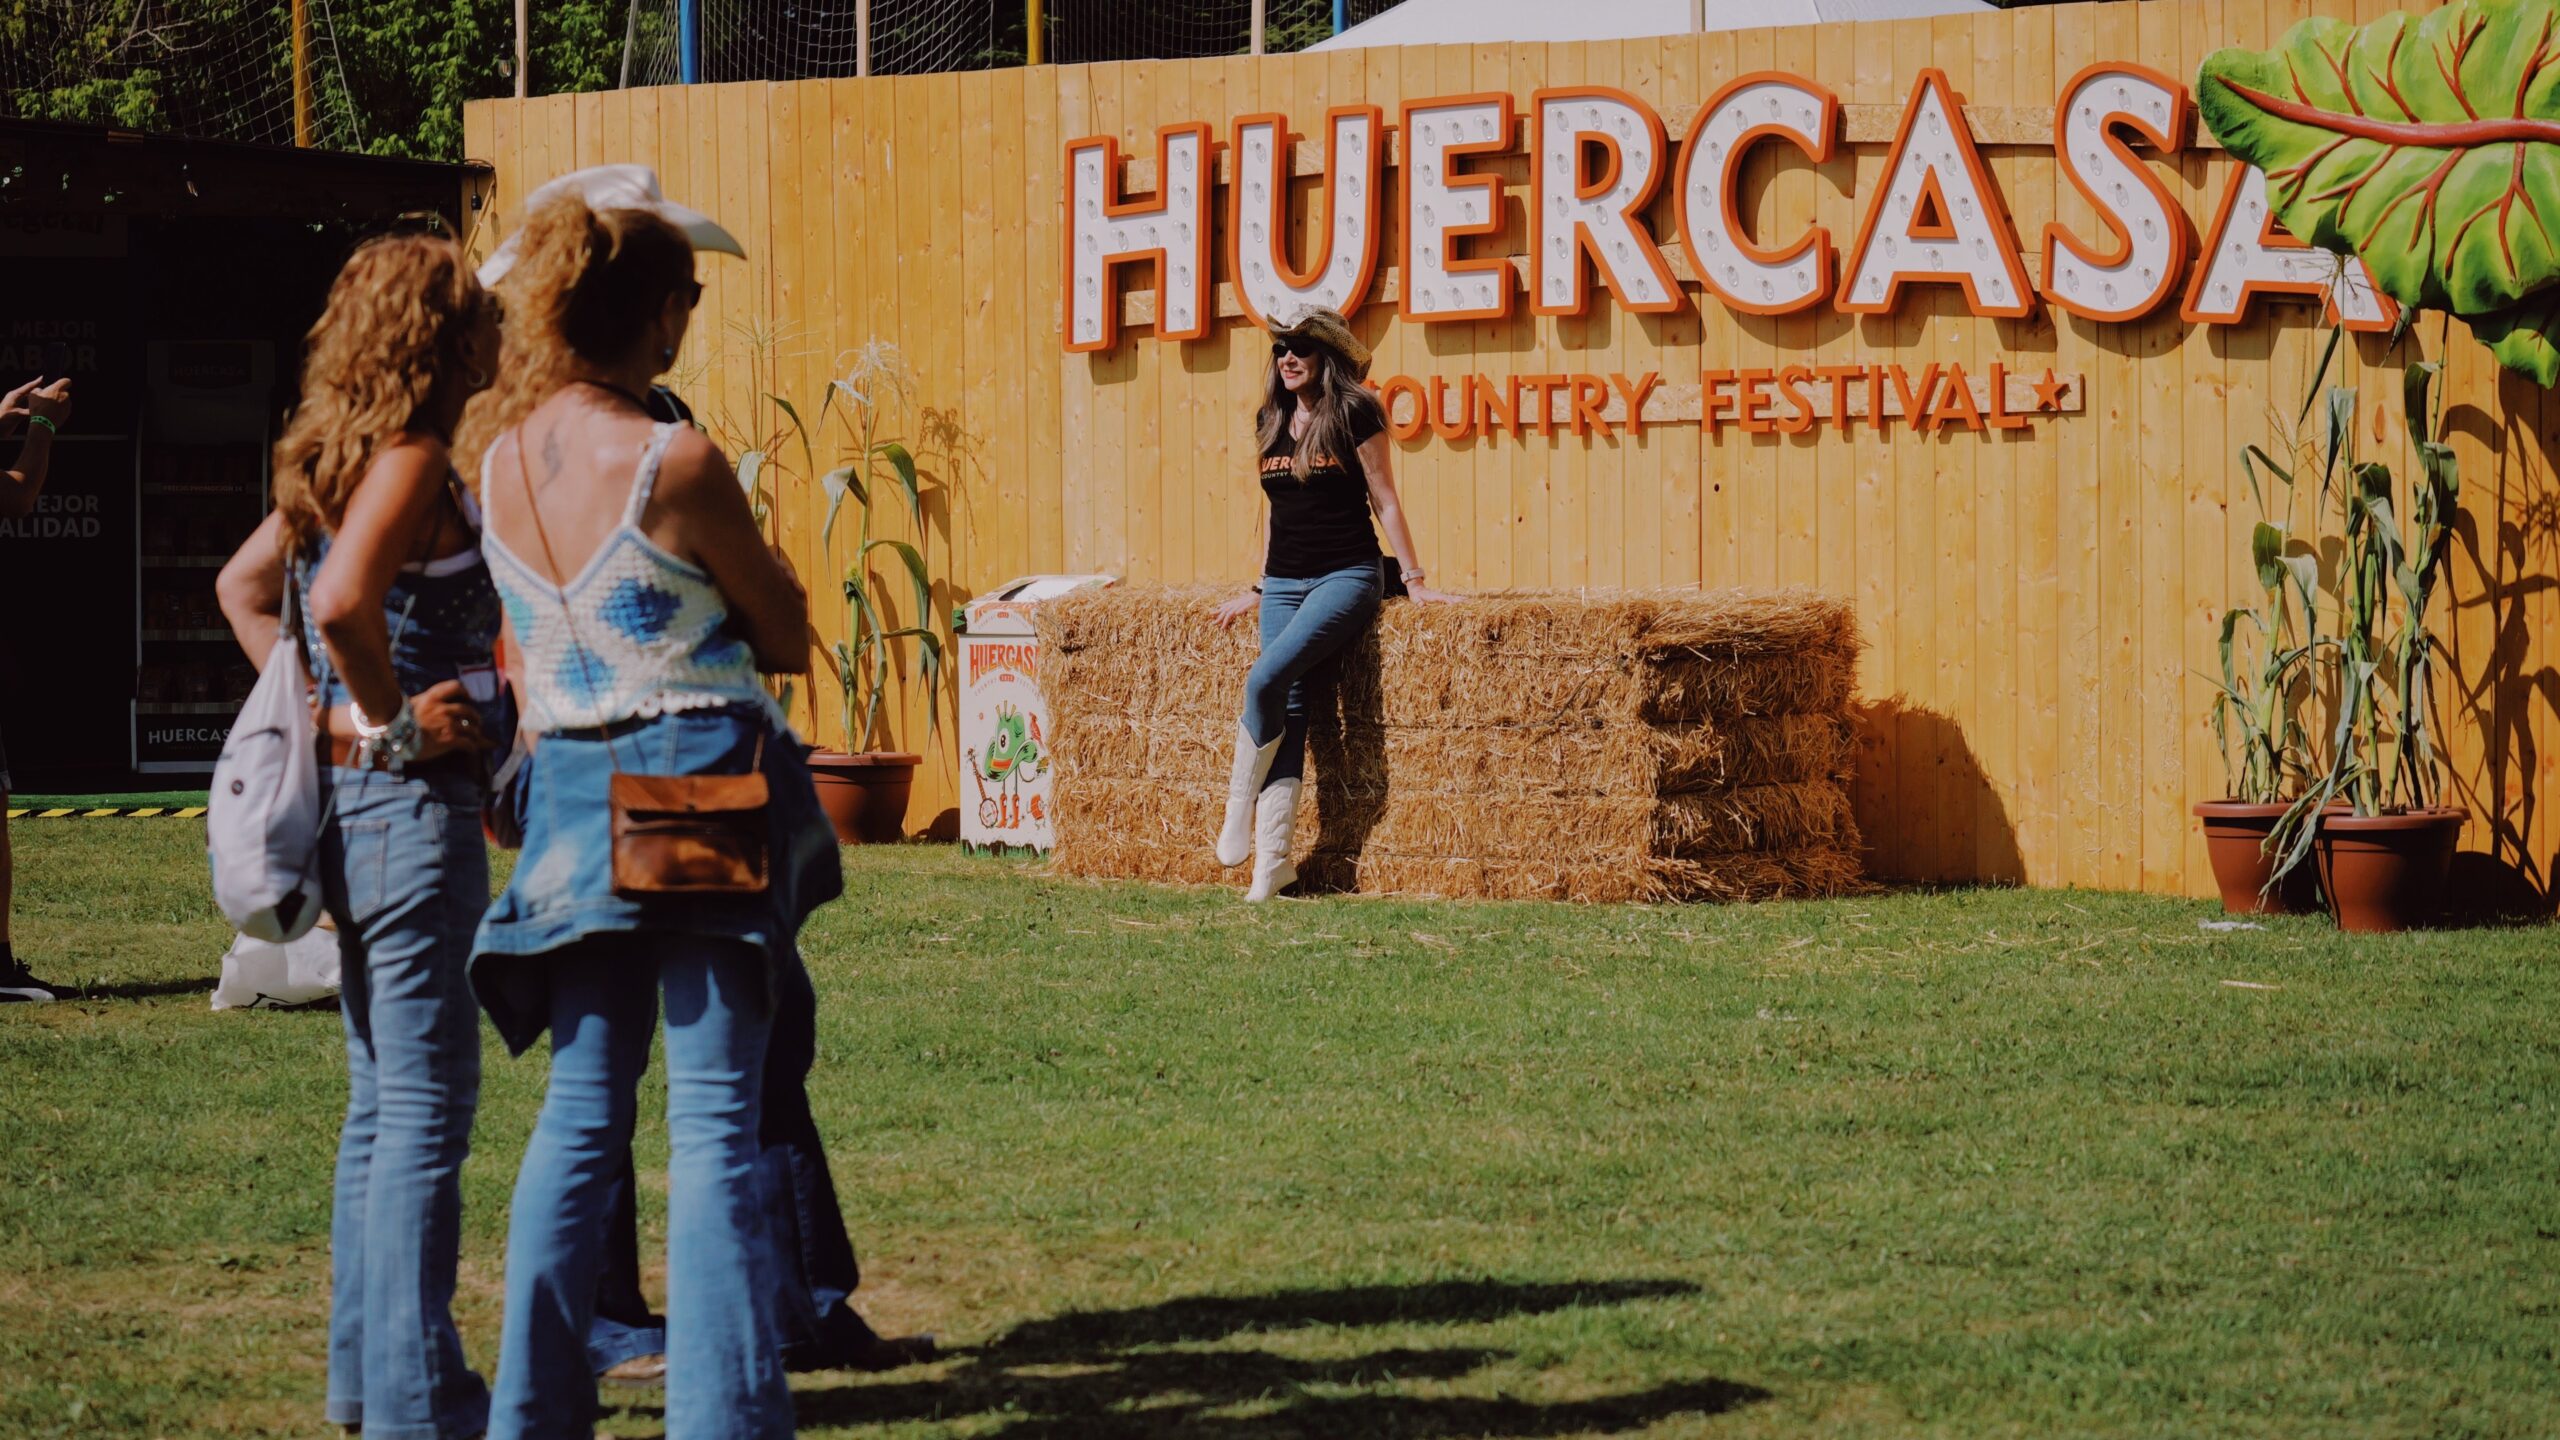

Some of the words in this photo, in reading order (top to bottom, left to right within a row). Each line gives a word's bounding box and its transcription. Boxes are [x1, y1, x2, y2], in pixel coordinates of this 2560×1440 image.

[1063, 61, 2401, 353] HUERCASA
[13, 320, 97, 338] MEJOR
[0, 345, 98, 372] ABR
[1365, 371, 1658, 441] OUNTRY
[1701, 362, 2028, 436] FESTIVAL
[37, 495, 99, 513] EJOR
[0, 517, 101, 538] ALIDAD
[148, 728, 231, 745] HUERCAS
